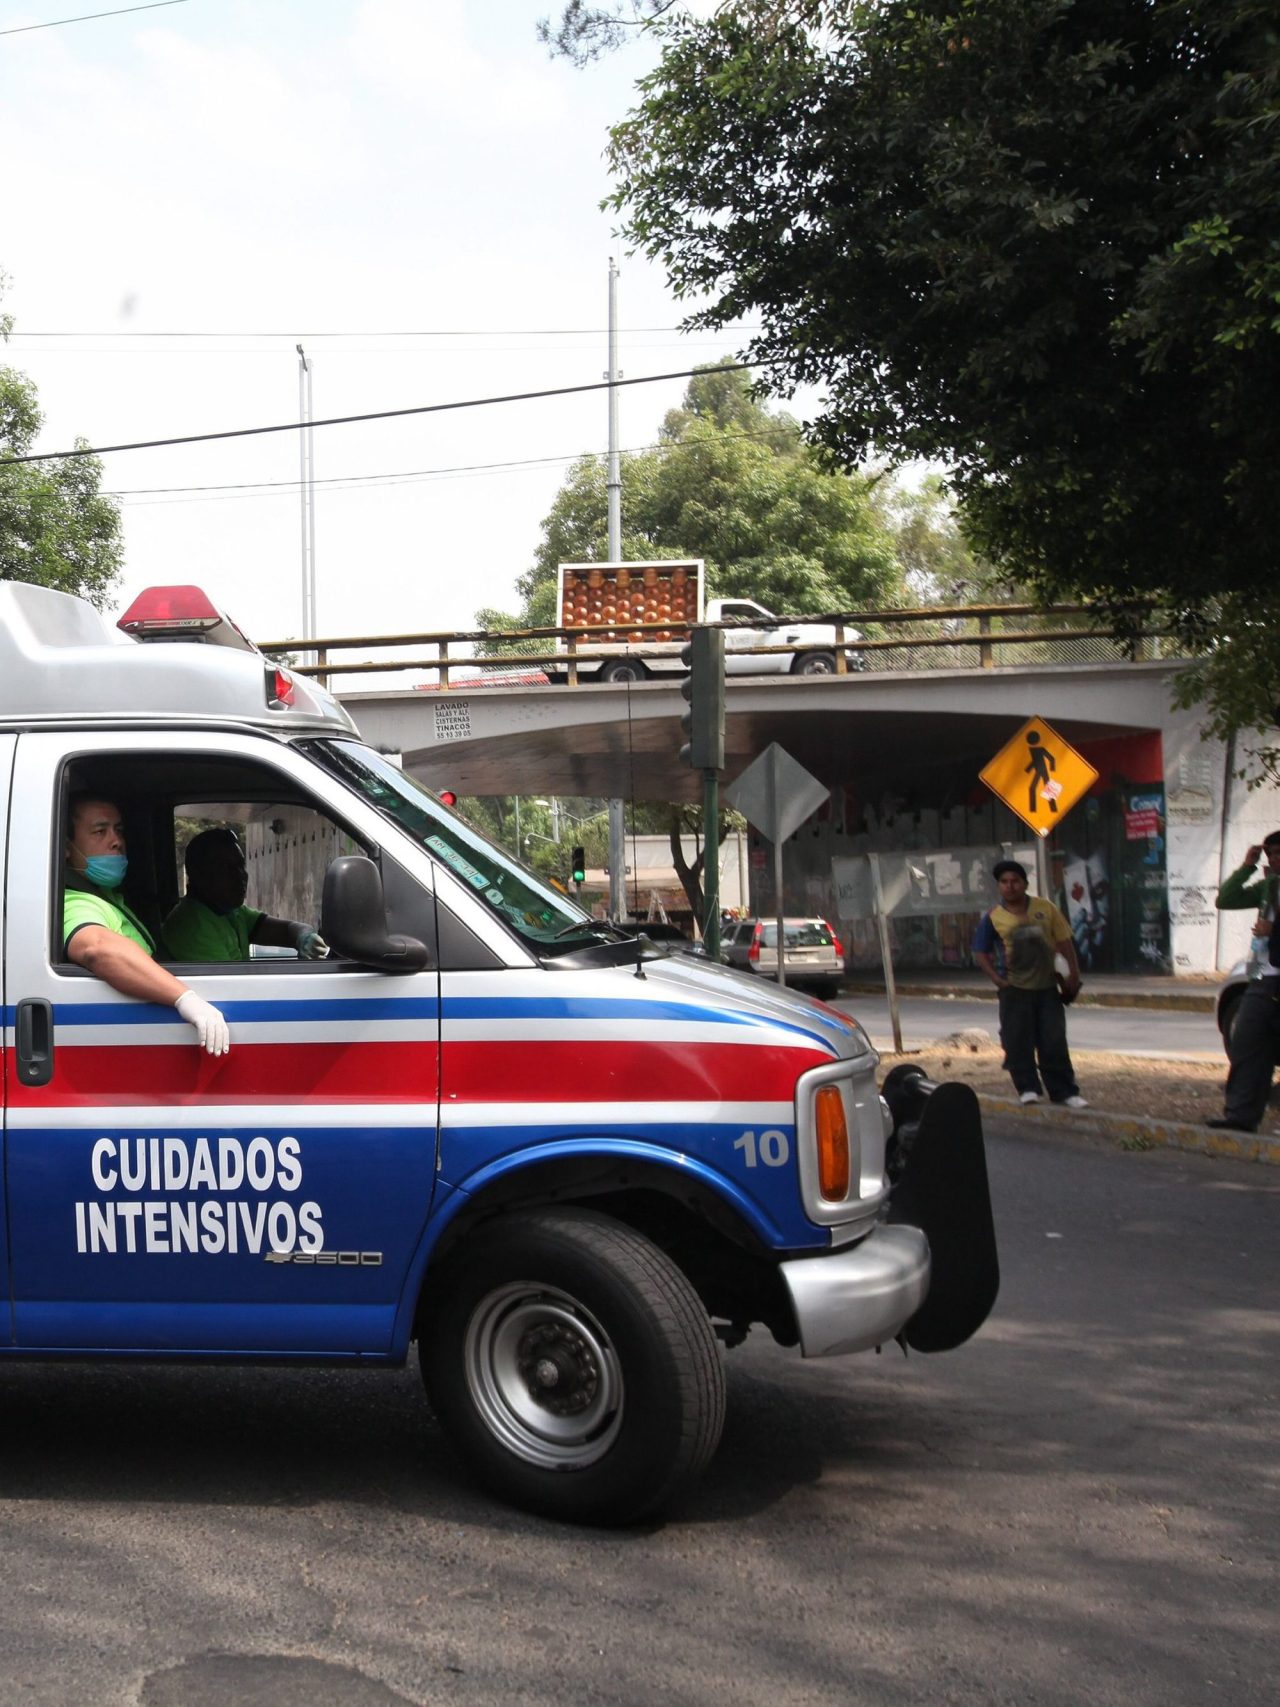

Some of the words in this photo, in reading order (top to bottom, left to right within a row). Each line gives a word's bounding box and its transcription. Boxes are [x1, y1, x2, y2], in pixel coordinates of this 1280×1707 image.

[435, 702, 469, 711] LAVADO
[436, 716, 470, 725] CISTERNAS
[436, 723, 471, 732] TINACOS
[733, 1129, 789, 1168] 10
[91, 1137, 303, 1192] CUIDADOS
[75, 1201, 325, 1255] INTENSIVOS
